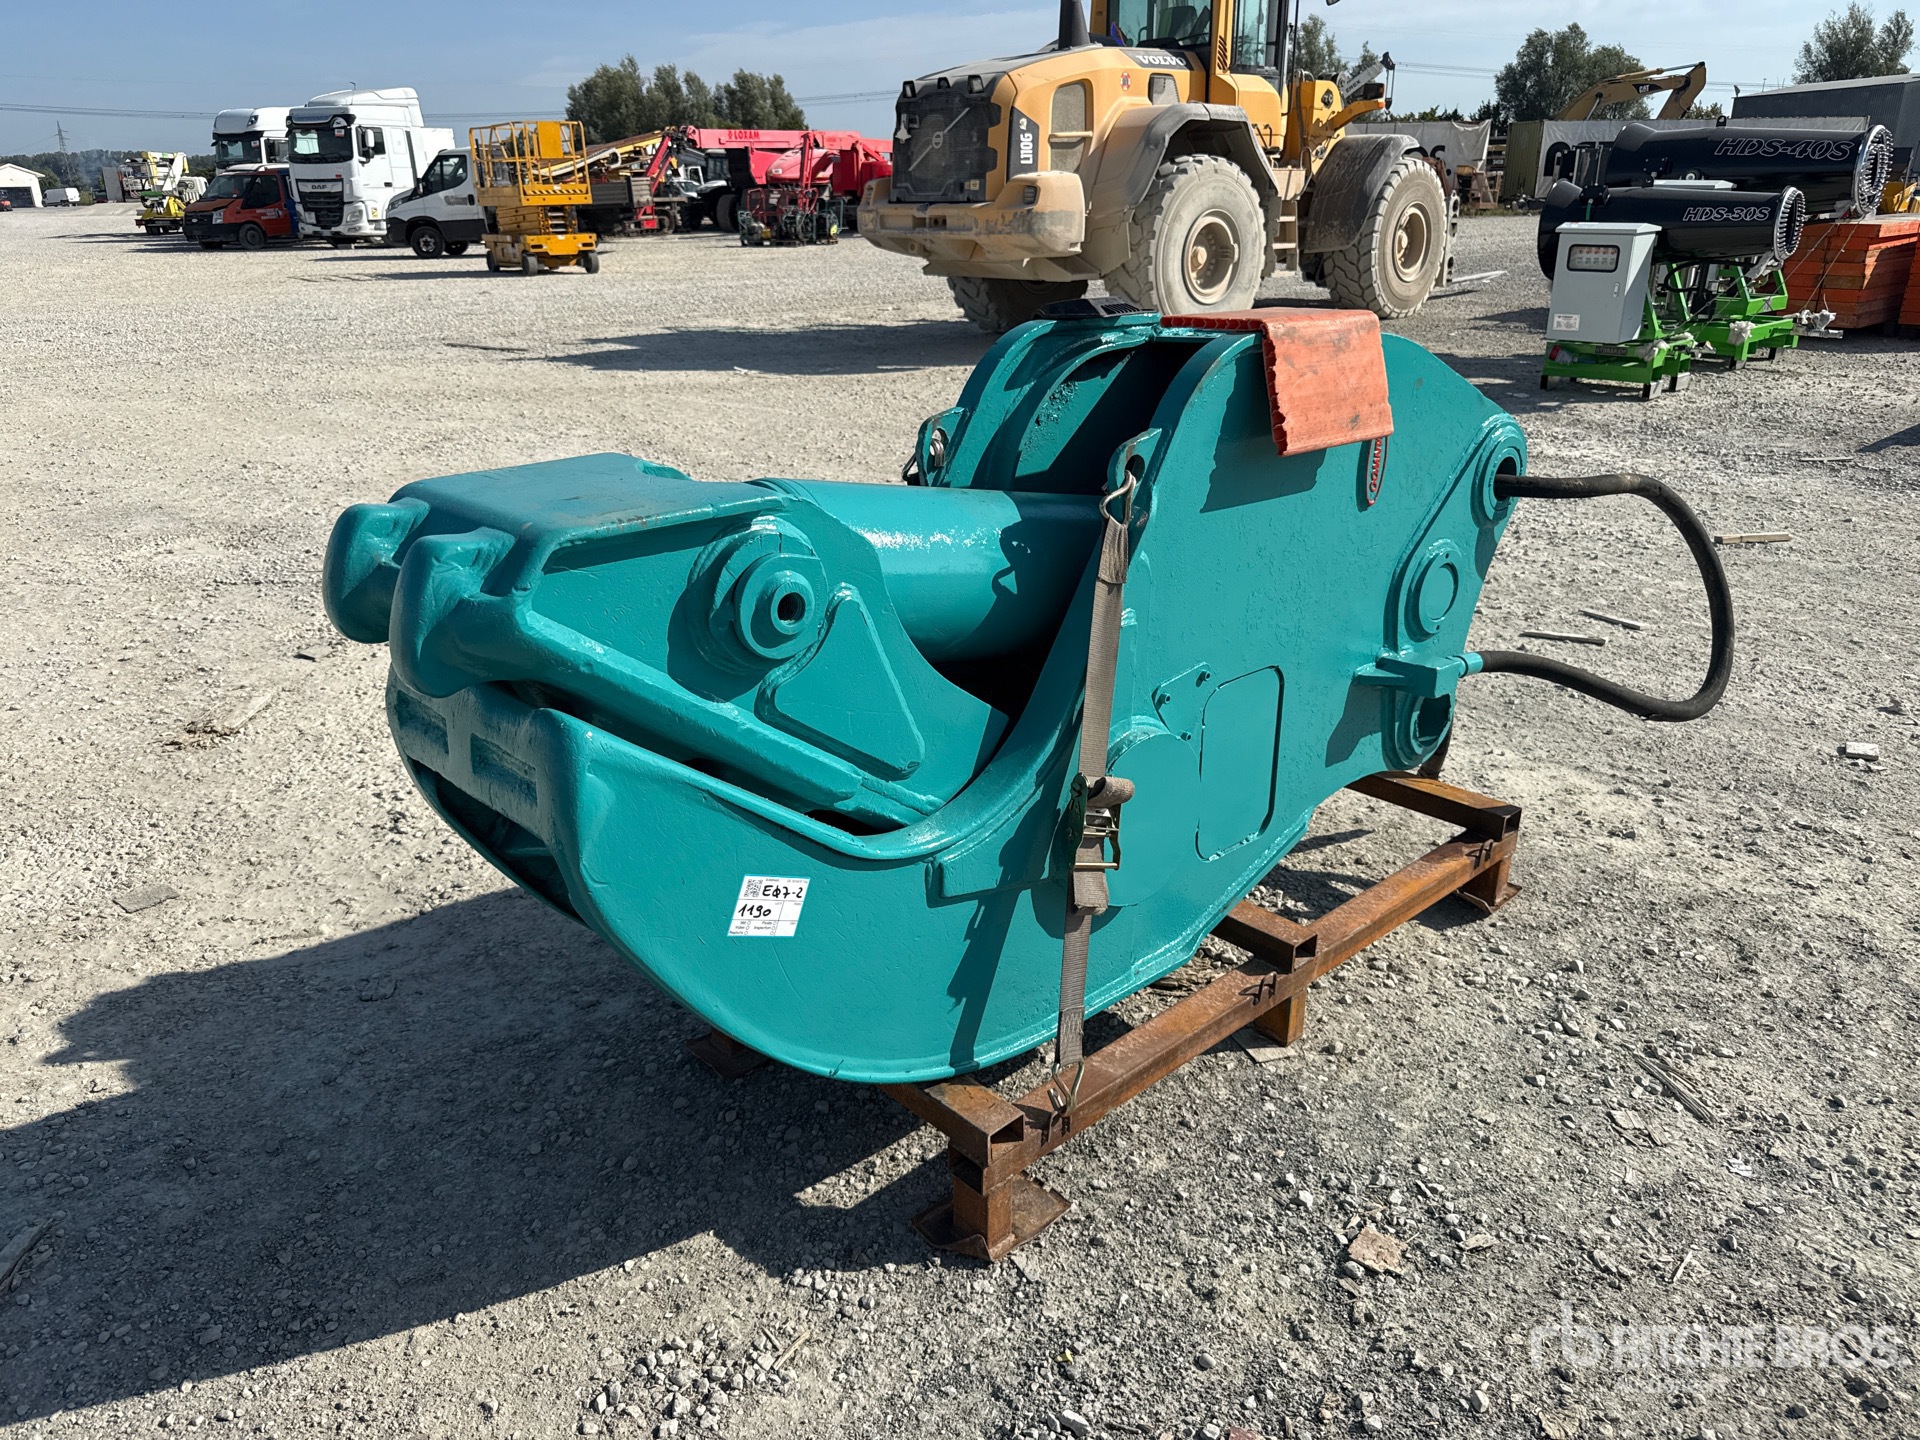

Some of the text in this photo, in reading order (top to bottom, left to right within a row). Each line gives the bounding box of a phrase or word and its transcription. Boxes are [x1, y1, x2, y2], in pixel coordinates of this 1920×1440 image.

[1136, 55, 1187, 66] VOLVO
[1639, 84, 1650, 94] CAT
[734, 130, 760, 140] LOXAM
[1020, 132, 1033, 165] L110G
[1714, 137, 1855, 161] HDS-40S
[1682, 206, 1771, 222] HDS-30S
[738, 903, 772, 919] 1190
